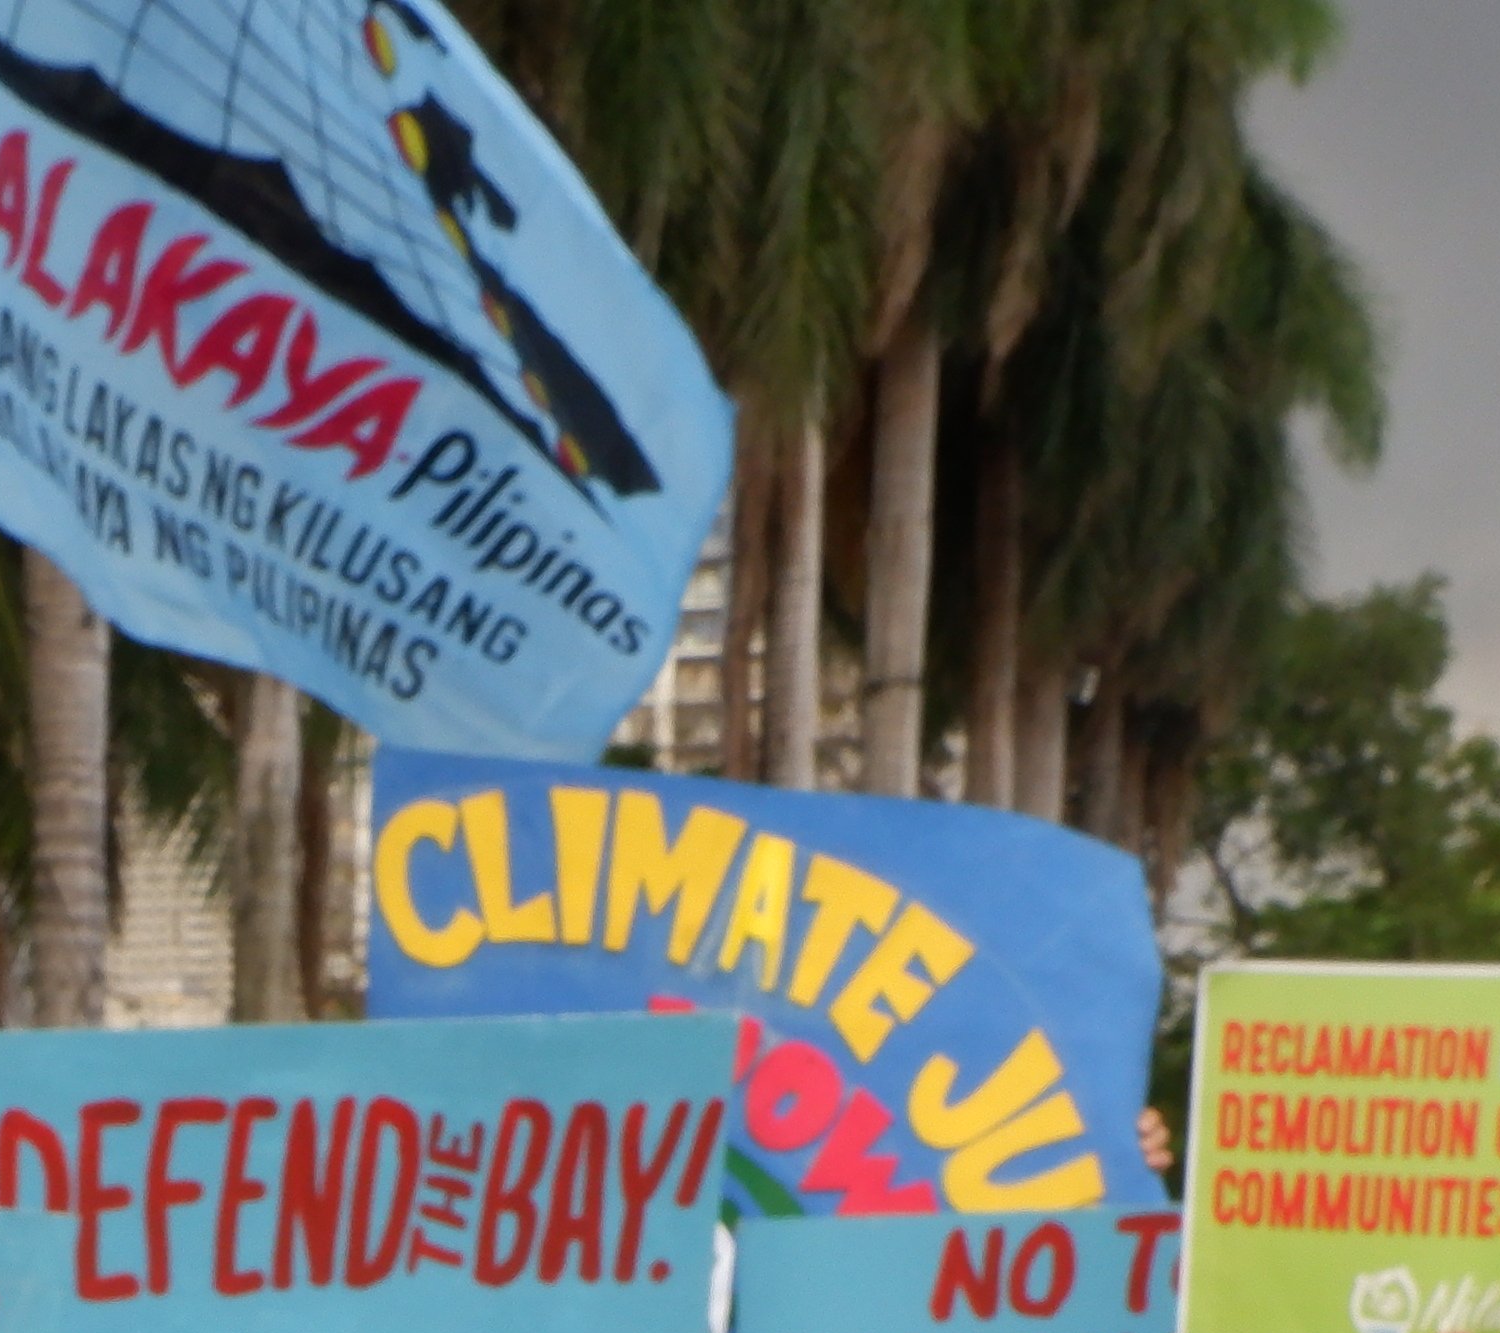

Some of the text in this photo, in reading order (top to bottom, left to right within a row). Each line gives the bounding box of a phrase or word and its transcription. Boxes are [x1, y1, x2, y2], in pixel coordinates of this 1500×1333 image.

[203, 448, 264, 535] NG
[265, 486, 528, 668] KILUSANG
[372, 784, 978, 1064] CLIMATE
[1216, 1091, 1479, 1158] DEMOLITION
[1219, 1021, 1492, 1082] RECLAMATION
[409, 1110, 486, 1275] THE
[473, 1095, 727, 1292] BAY!
[929, 1210, 1184, 1324] NO T
